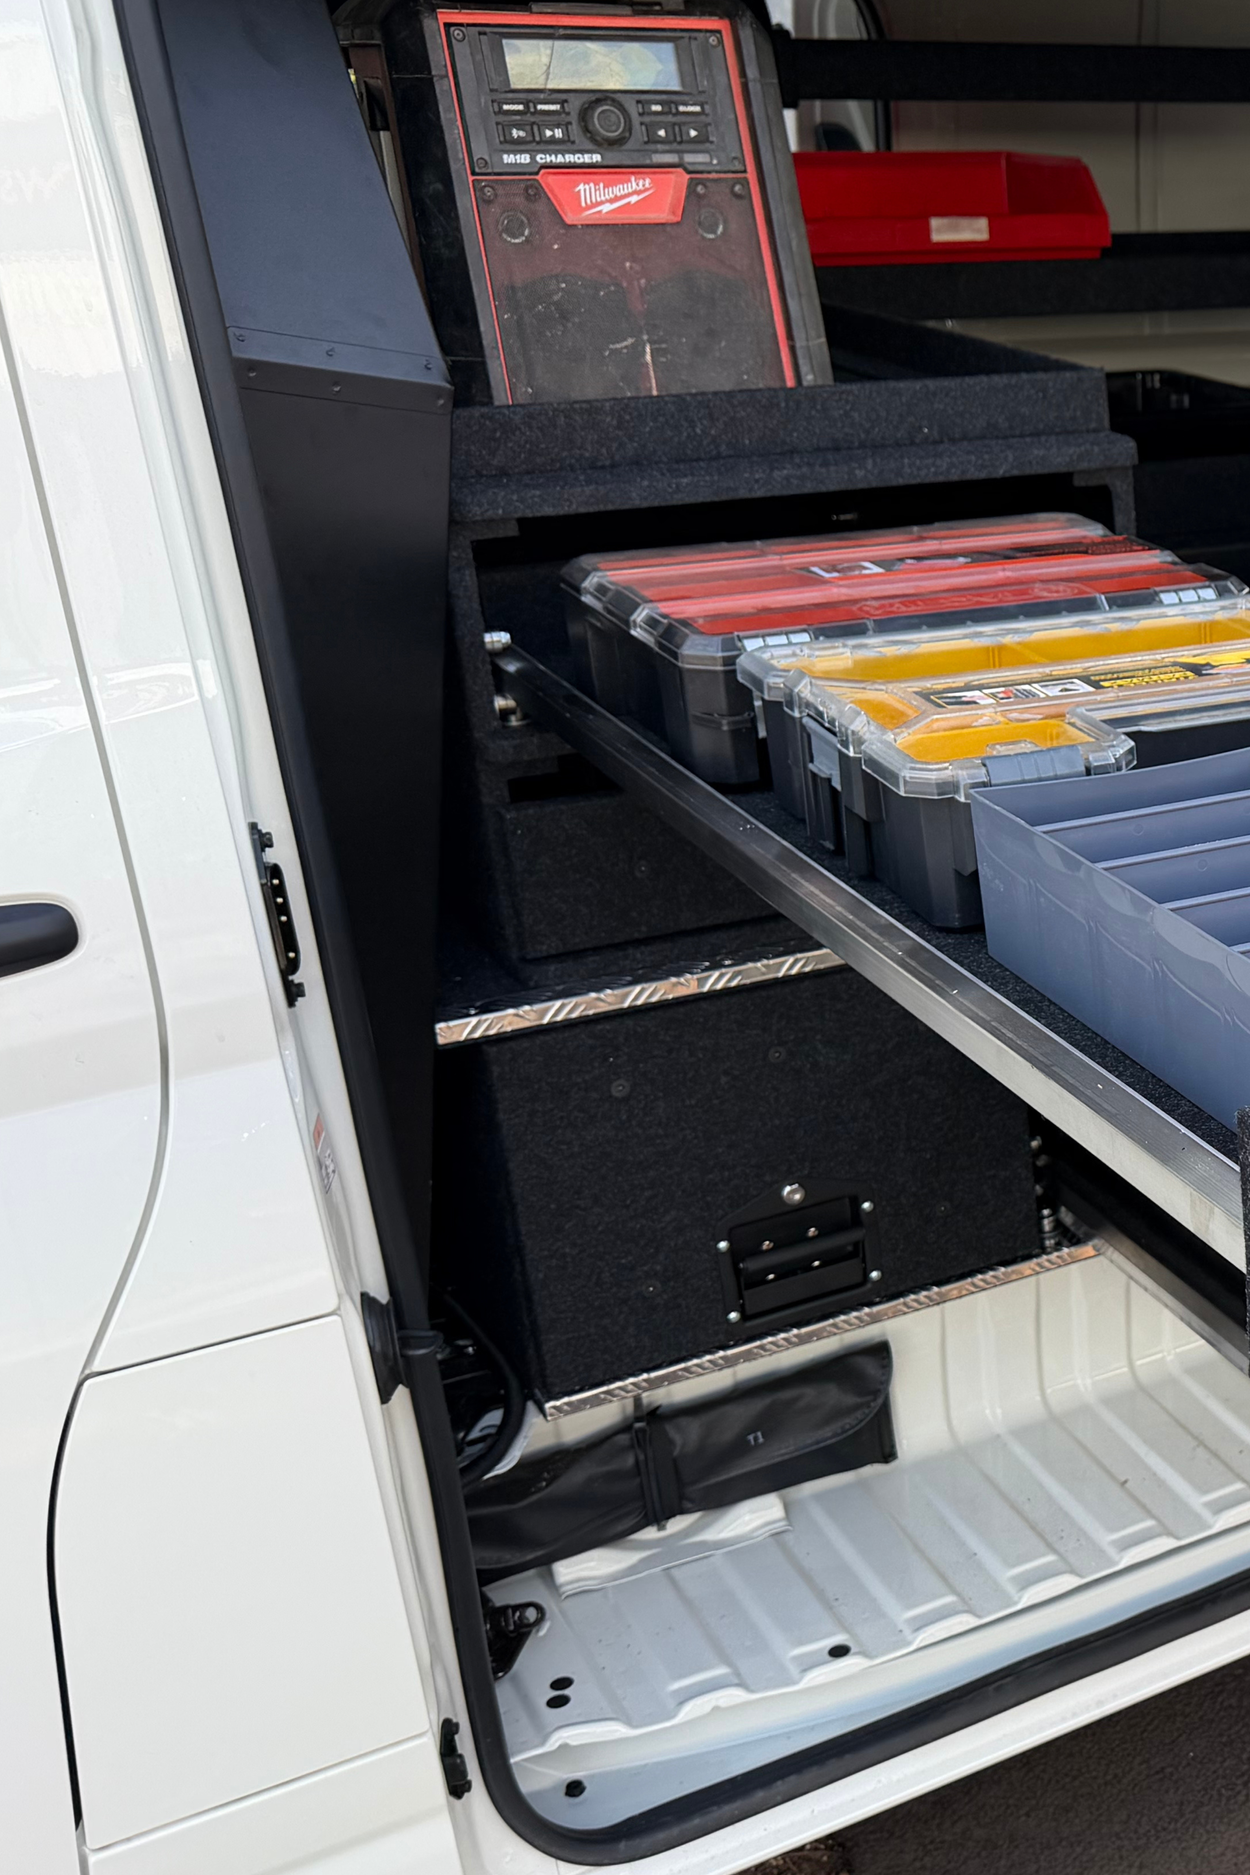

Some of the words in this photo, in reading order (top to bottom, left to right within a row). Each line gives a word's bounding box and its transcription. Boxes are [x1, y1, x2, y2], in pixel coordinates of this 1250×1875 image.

[502, 153, 531, 164] M18
[535, 153, 602, 163] CHARGER
[575, 176, 652, 207] Milwaukee
